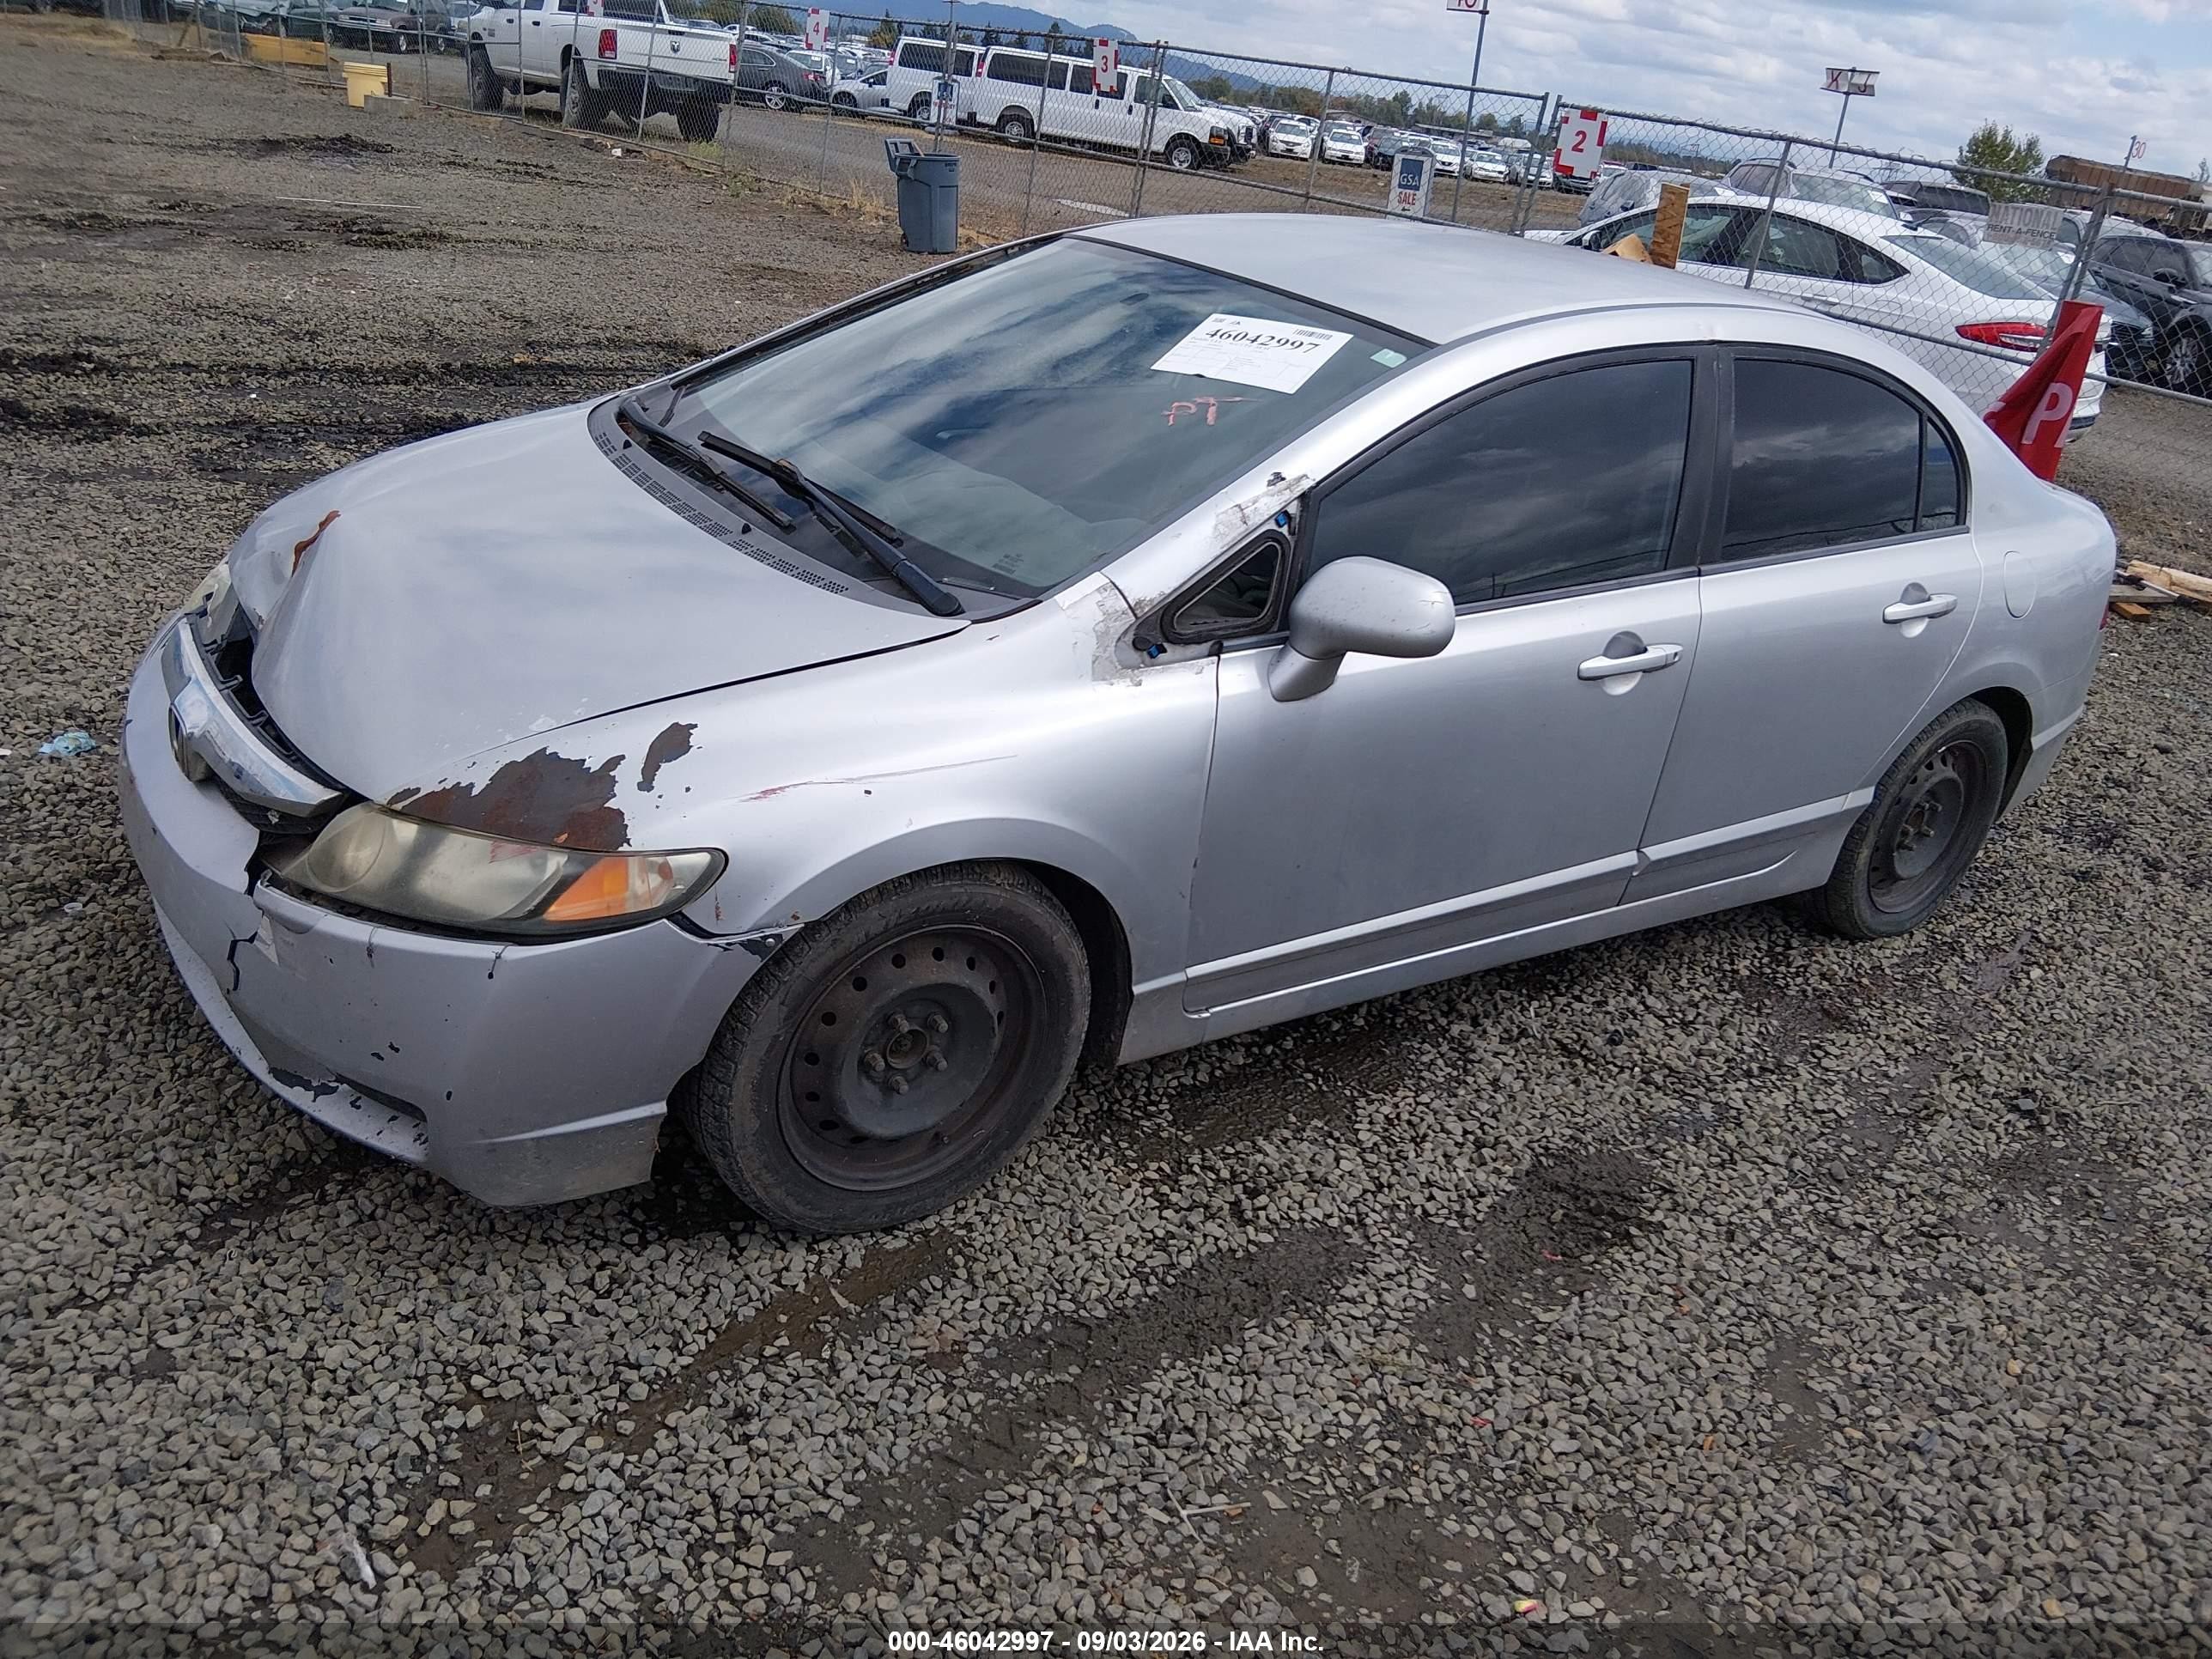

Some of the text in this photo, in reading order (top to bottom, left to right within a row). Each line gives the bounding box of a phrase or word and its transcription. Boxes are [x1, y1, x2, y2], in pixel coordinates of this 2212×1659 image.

[812, 21, 820, 36] 4
[1101, 55, 1109, 73] 3
[1827, 69, 1843, 90] K
[1857, 73, 1871, 94] J
[1571, 130, 1588, 153] 2
[2131, 141, 2147, 159] 30
[1400, 173, 1420, 186] GSA
[1397, 191, 1417, 206] SALE
[1990, 204, 2060, 231] NATIONAL
[1205, 328, 1322, 354] 46042997
